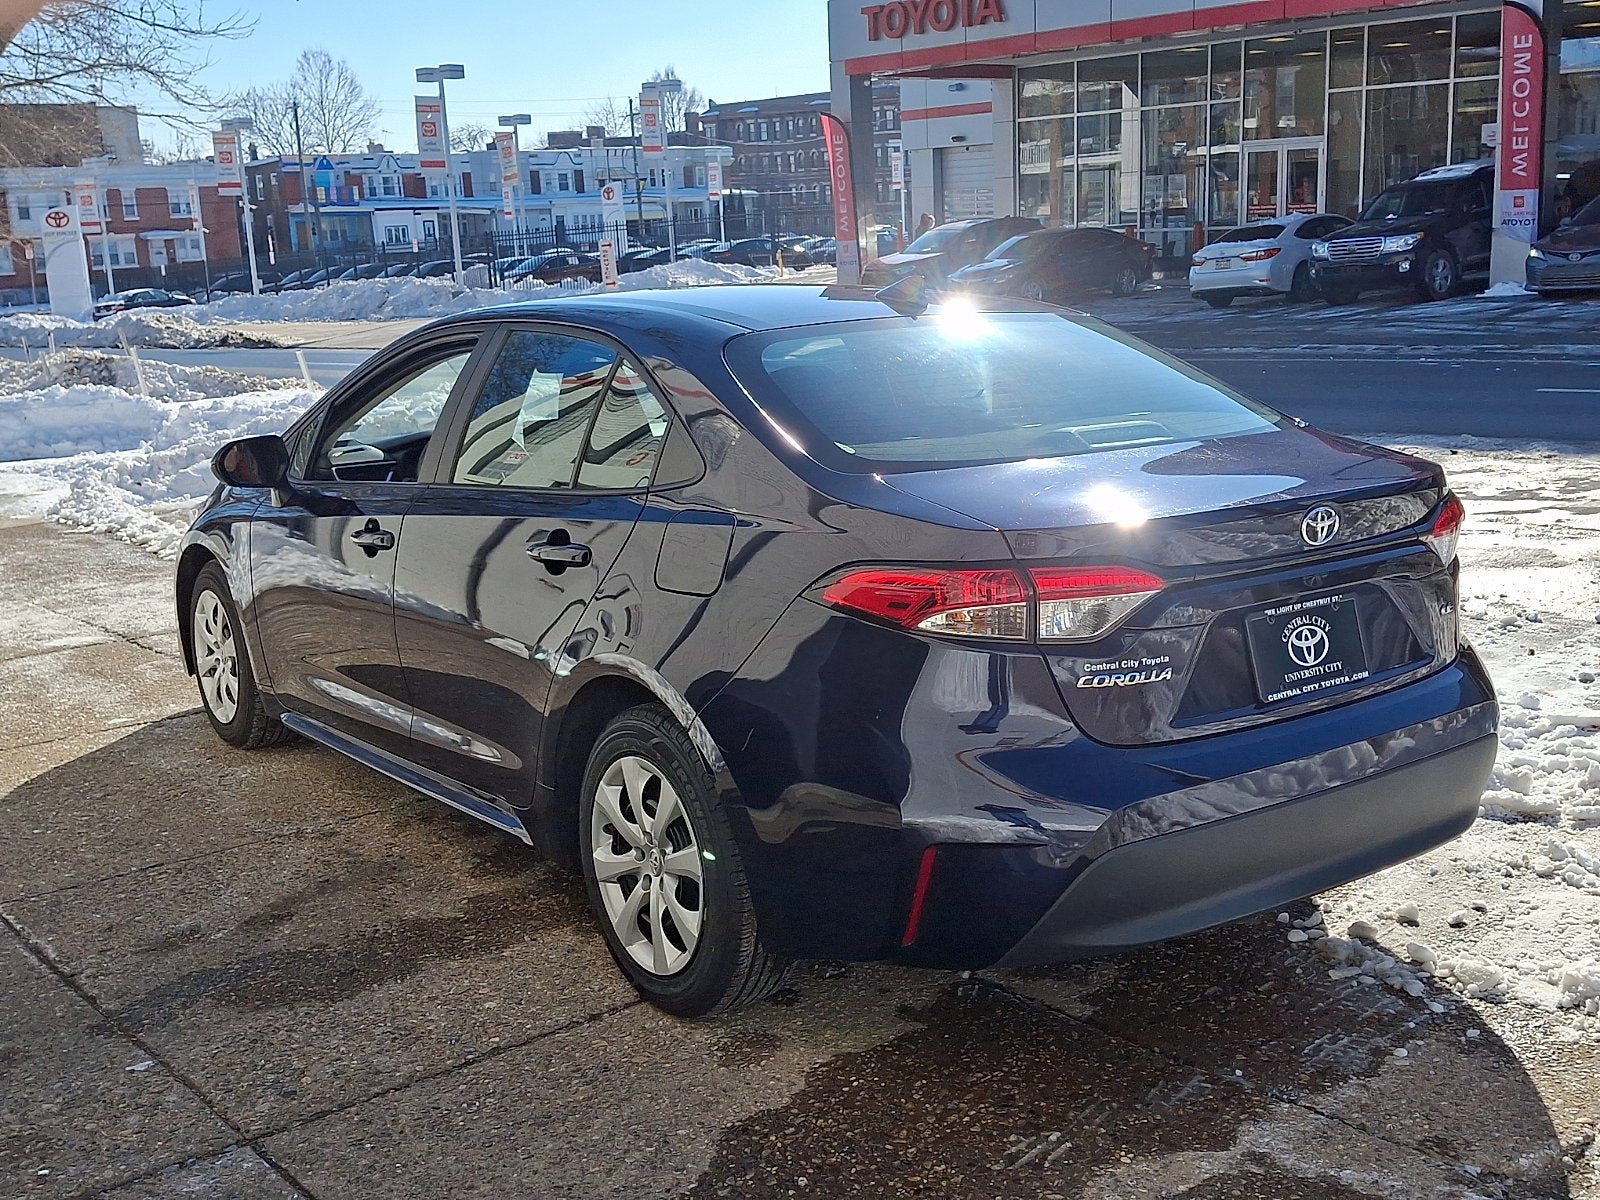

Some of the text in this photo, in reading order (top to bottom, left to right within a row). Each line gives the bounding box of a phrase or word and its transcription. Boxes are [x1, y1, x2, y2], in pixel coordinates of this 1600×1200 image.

[861, 0, 1005, 41] TOYOTA
[1276, 606, 1293, 614] LIGHT
[1302, 599, 1330, 608] CHESTNUT
[1281, 614, 1332, 642] CENTRAL CITY
[1084, 655, 1170, 671] Central City Toyota
[1284, 661, 1343, 682] UNIVERSITY CITY
[1076, 667, 1173, 688] COROLLA
[1267, 670, 1369, 701] CENTRAL CITY TOYOTA .COM
